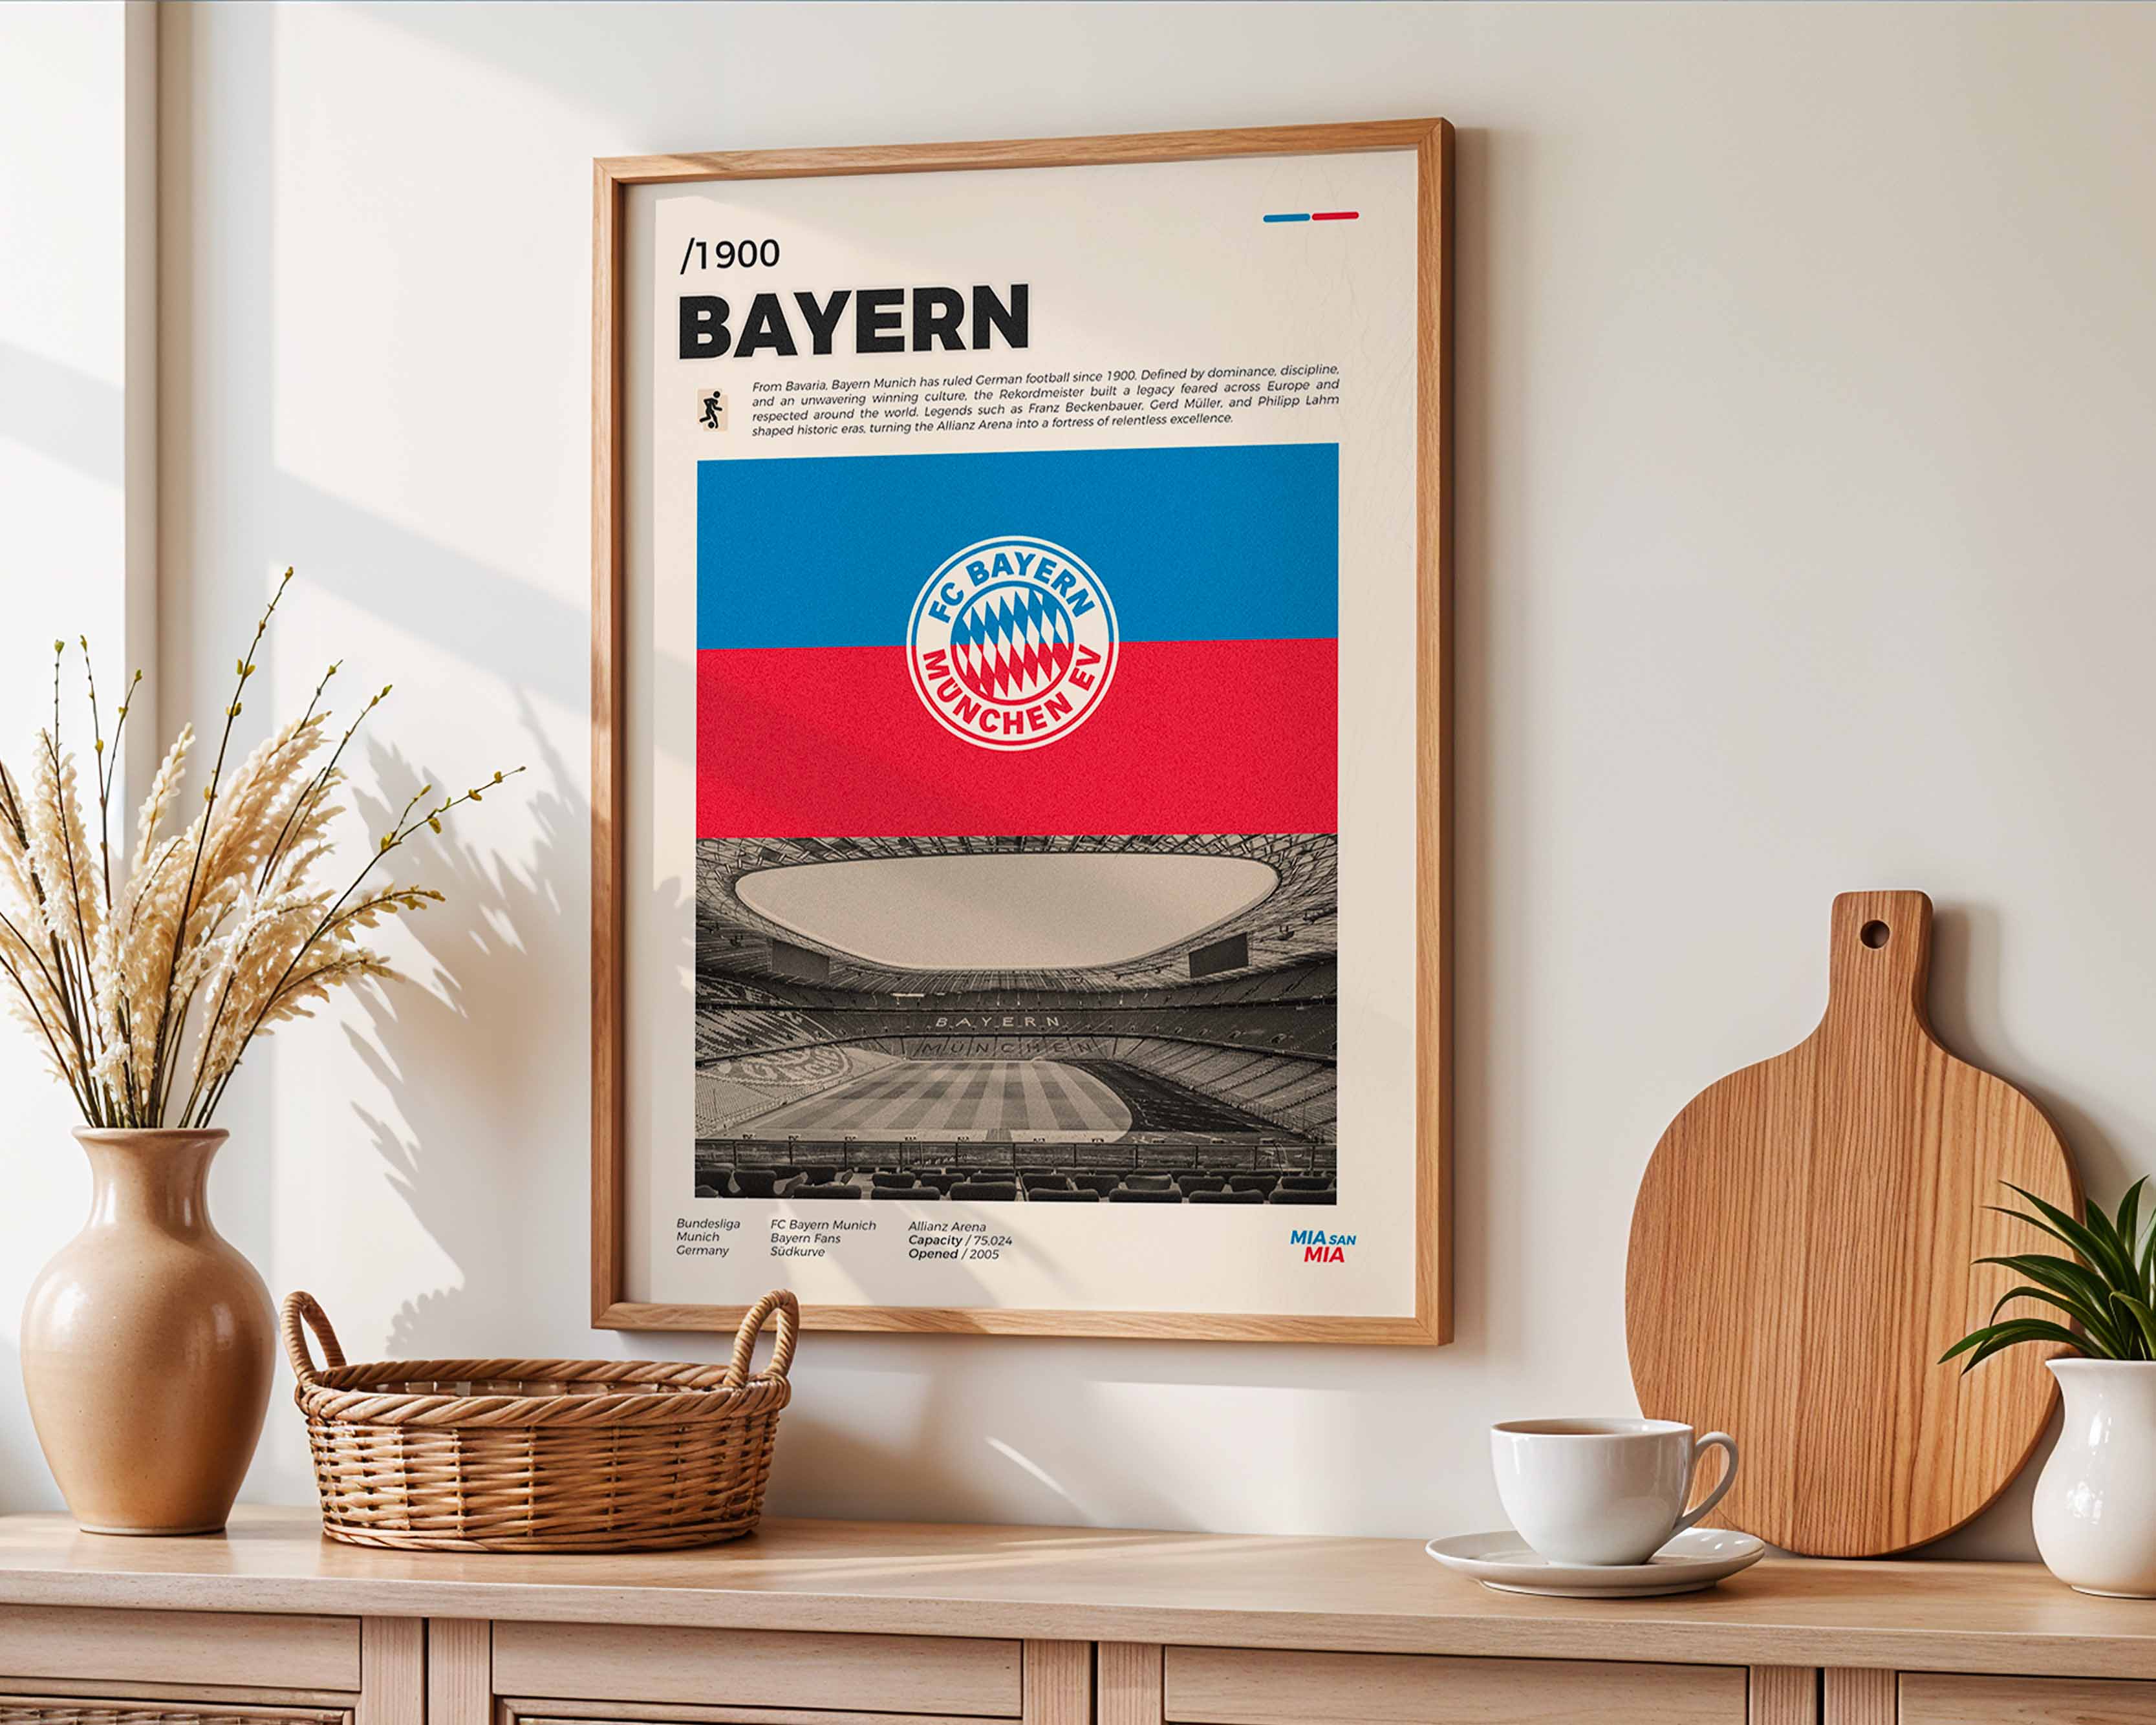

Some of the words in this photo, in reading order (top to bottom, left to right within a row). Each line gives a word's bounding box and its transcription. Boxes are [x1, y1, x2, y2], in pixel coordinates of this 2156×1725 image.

[680, 237, 780, 275] /1900
[680, 284, 1028, 359] BAYERN
[752, 381, 782, 393] From
[831, 378, 871, 392] Bayern
[872, 376, 917, 389] Munich
[919, 376, 940, 388] has
[942, 374, 973, 387] ruled
[975, 374, 1023, 386] German
[1025, 371, 1071, 385] football
[1072, 370, 1103, 383] since
[1107, 369, 1137, 382] 1900.
[1140, 367, 1188, 381] Defined
[1189, 367, 1206, 381] by
[751, 395, 775, 408] and
[779, 397, 795, 407] an
[800, 392, 867, 407] unwavering
[871, 391, 920, 405] winning
[973, 389, 994, 401] the
[998, 386, 1085, 400] Rekordmeister
[1090, 385, 1118, 398] built
[1122, 386, 1131, 396] a
[1136, 383, 1176, 398] legacy
[1180, 381, 1219, 394] feared
[1223, 383, 1261, 394] across
[1267, 380, 1311, 393] Europe
[1315, 378, 1341, 391] and
[751, 409, 809, 424] respected
[812, 408, 856, 421] around
[859, 407, 880, 420] the
[884, 405, 919, 418] world.
[924, 404, 973, 420] Legends
[977, 403, 1006, 416] such
[1009, 405, 1024, 414] as
[1028, 402, 1061, 414] Franz
[1149, 398, 1180, 411] Gerd
[1228, 395, 1253, 409] and
[1257, 394, 1300, 409] Philipp
[1305, 393, 1340, 406] Lahm
[751, 424, 795, 438] shaped
[796, 423, 839, 435] historic
[869, 421, 912, 435] turning
[914, 420, 934, 433] the
[936, 419, 976, 432] Allianz
[977, 419, 1013, 430] Arena
[1015, 418, 1040, 429] into
[1040, 419, 1050, 429] a
[1051, 416, 1095, 429] fortress
[1096, 414, 1111, 427] of
[1111, 414, 1168, 427] relentless
[1169, 412, 1234, 425] excellence.
[928, 581, 964, 623] FC
[965, 552, 1095, 618] BAYERN
[923, 649, 1073, 734] MÜNCHEN
[1068, 644, 1101, 691] EV
[935, 1016, 1059, 1028] BAYERN
[921, 1040, 1093, 1057] MÜNCHEN
[676, 1217, 741, 1232] Bundesliga
[770, 1219, 787, 1230] FC
[788, 1219, 830, 1233] Bayern
[832, 1219, 877, 1231] Munich
[907, 1220, 949, 1233] Allianz
[950, 1221, 987, 1234] Arena
[676, 1231, 720, 1243] Munich
[770, 1232, 812, 1246] Bayern
[812, 1231, 842, 1245] Fans
[908, 1234, 964, 1248] Capacity
[964, 1234, 973, 1247] /
[973, 1234, 1013, 1247] 75.024
[1289, 1230, 1326, 1245] MIA
[1328, 1234, 1357, 1246] SAN
[676, 1244, 730, 1259] Germany
[770, 1245, 826, 1258] Südkurve
[908, 1247, 958, 1261] Opened
[960, 1247, 969, 1261] /
[969, 1248, 1000, 1261] 2005
[1303, 1246, 1345, 1263] MIA
